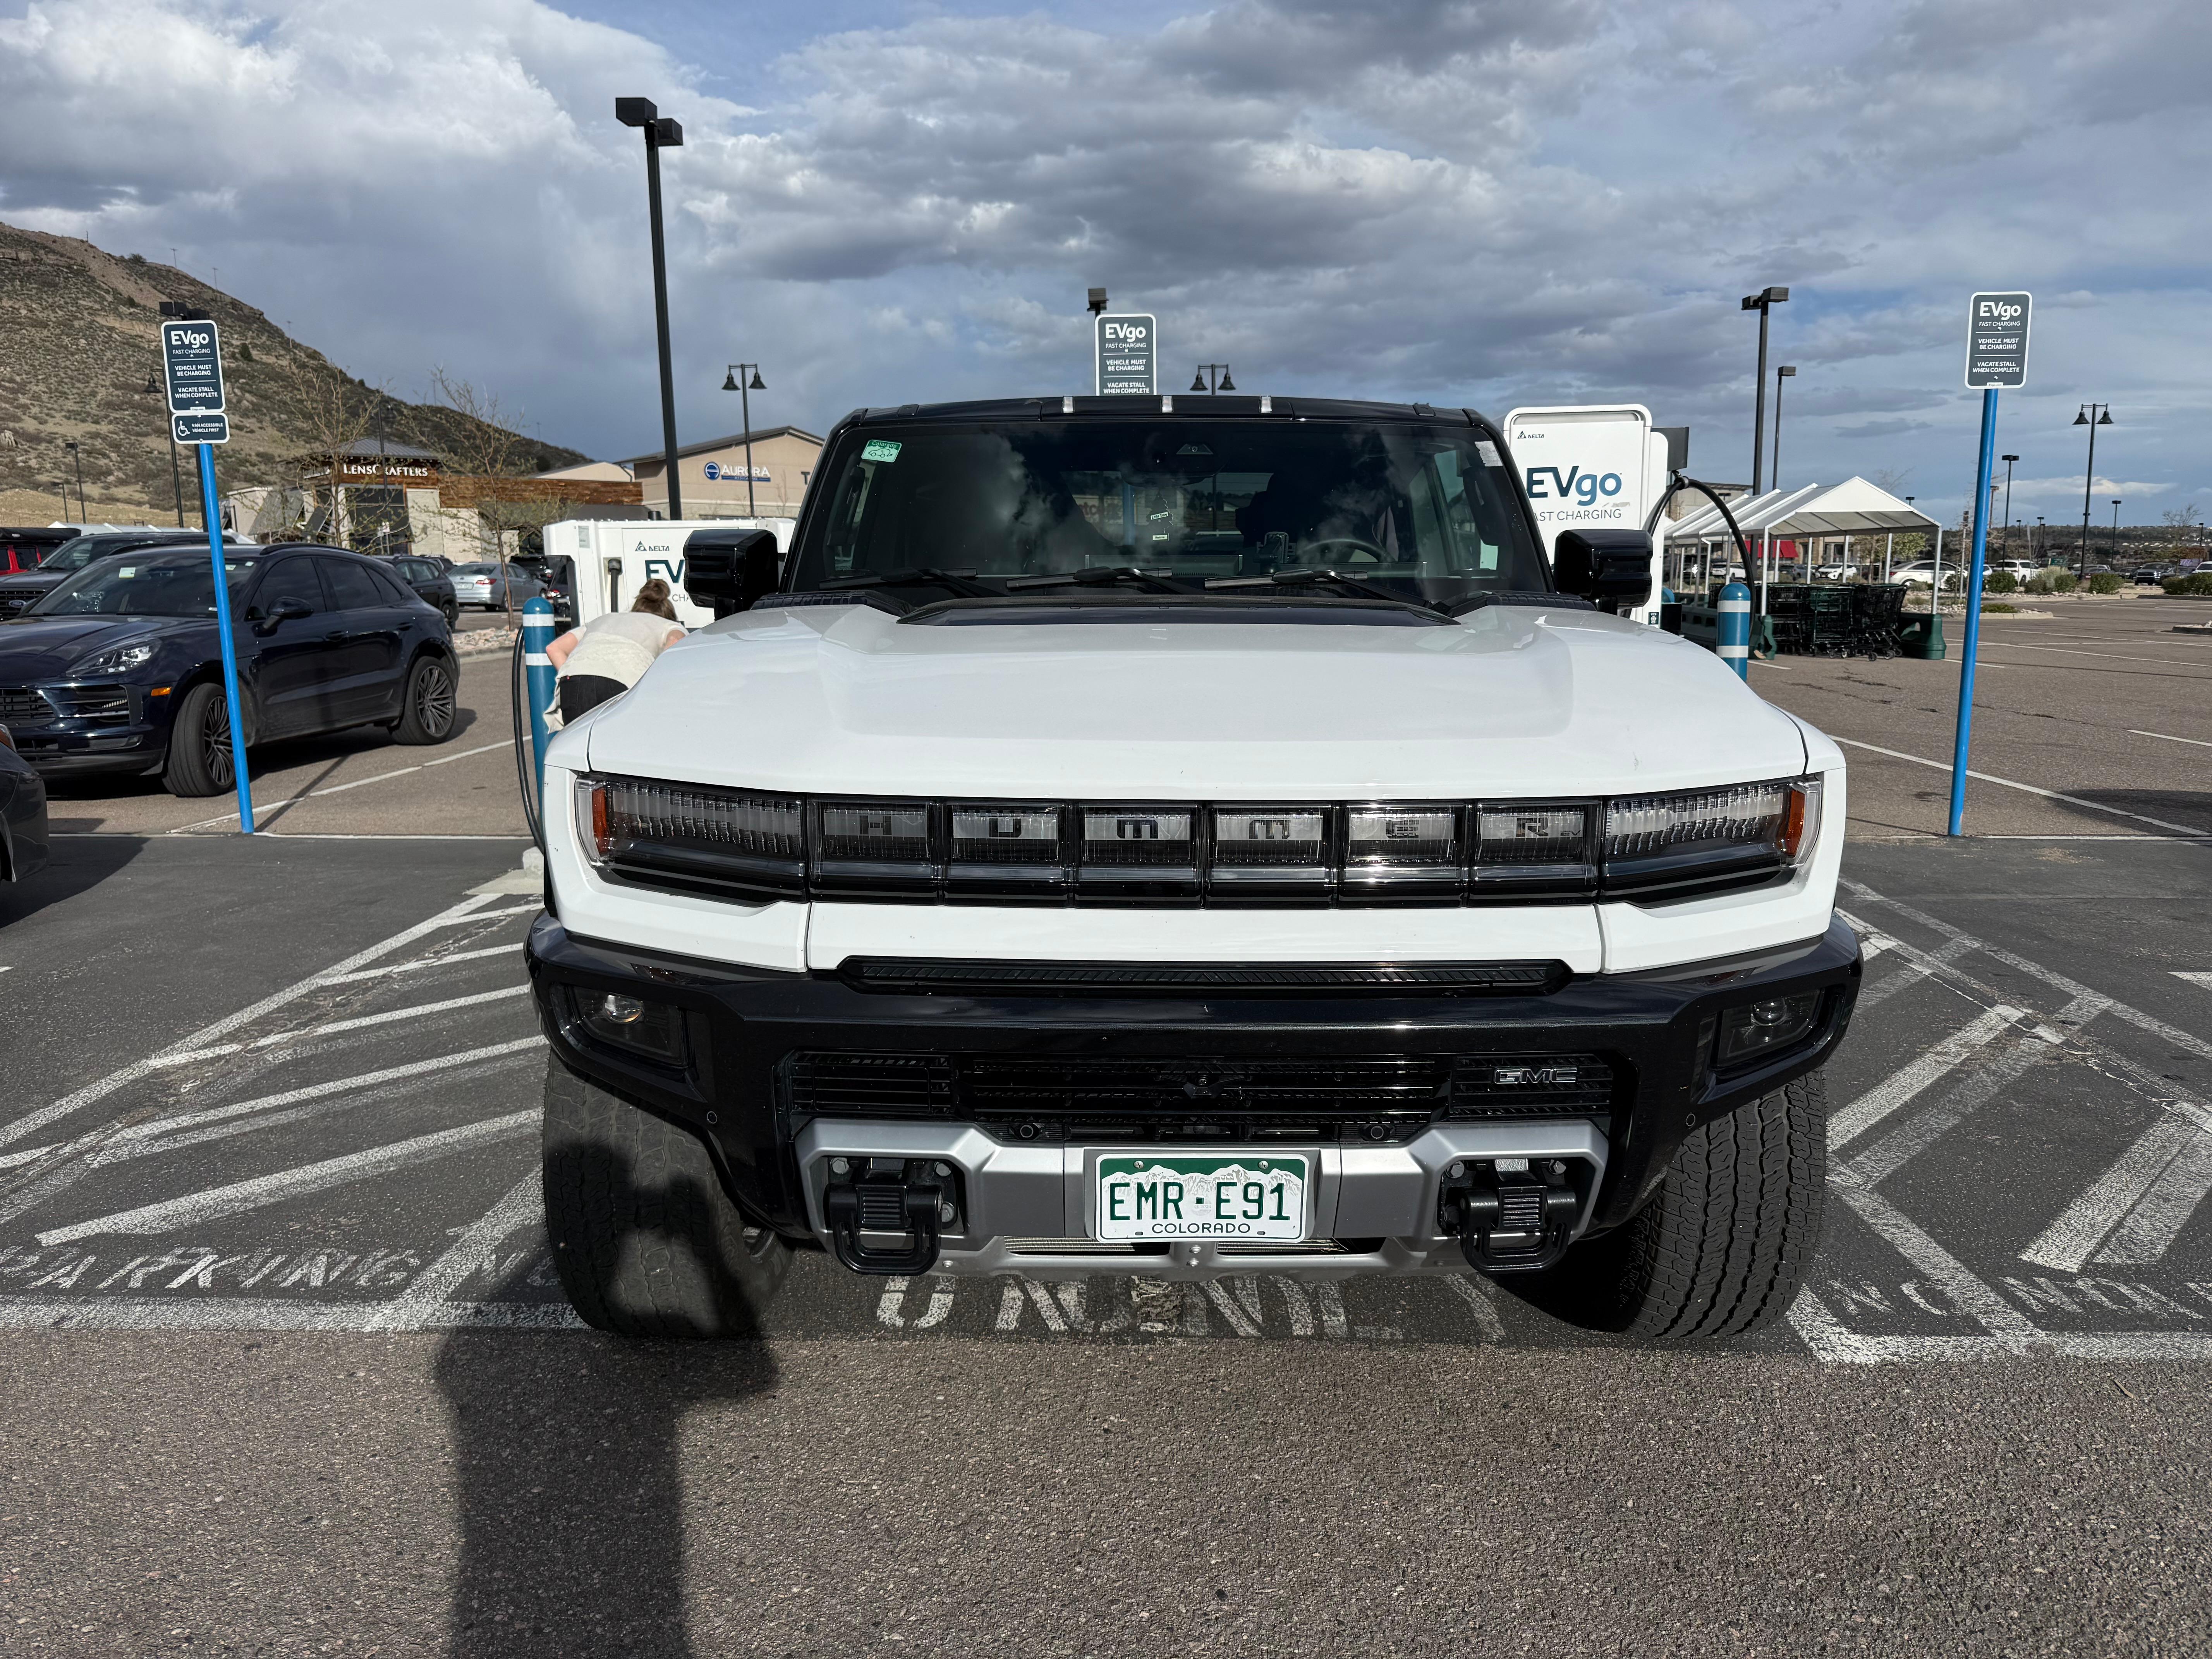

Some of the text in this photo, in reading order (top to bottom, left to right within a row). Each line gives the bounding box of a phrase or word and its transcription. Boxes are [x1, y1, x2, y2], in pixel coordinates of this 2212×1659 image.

[1979, 301, 2021, 320] EVgo
[171, 330, 209, 348] EVgo
[1105, 323, 1146, 342] EVgo
[1527, 465, 1622, 506] EVgo
[1557, 509, 1621, 521] CHARGING
[1494, 1067, 1577, 1084] GMC
[1152, 1223, 1251, 1234] COLORADO
